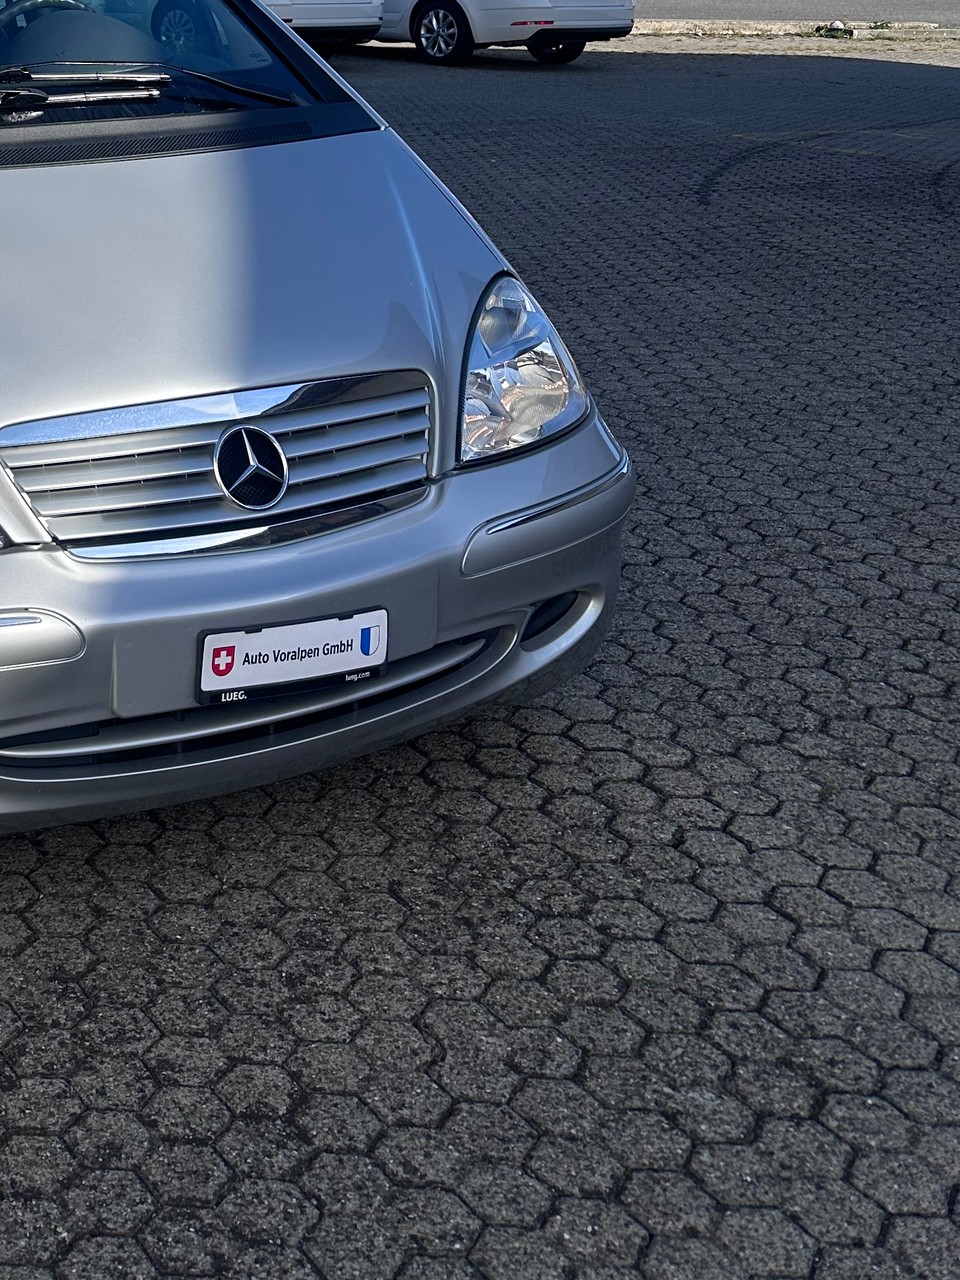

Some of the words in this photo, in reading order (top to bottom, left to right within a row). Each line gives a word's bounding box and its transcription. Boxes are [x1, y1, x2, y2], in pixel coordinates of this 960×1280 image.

[242, 652, 270, 666] Auto
[272, 646, 320, 662] Voralpen
[322, 639, 354, 656] GmbH
[221, 691, 247, 702] LUEG.
